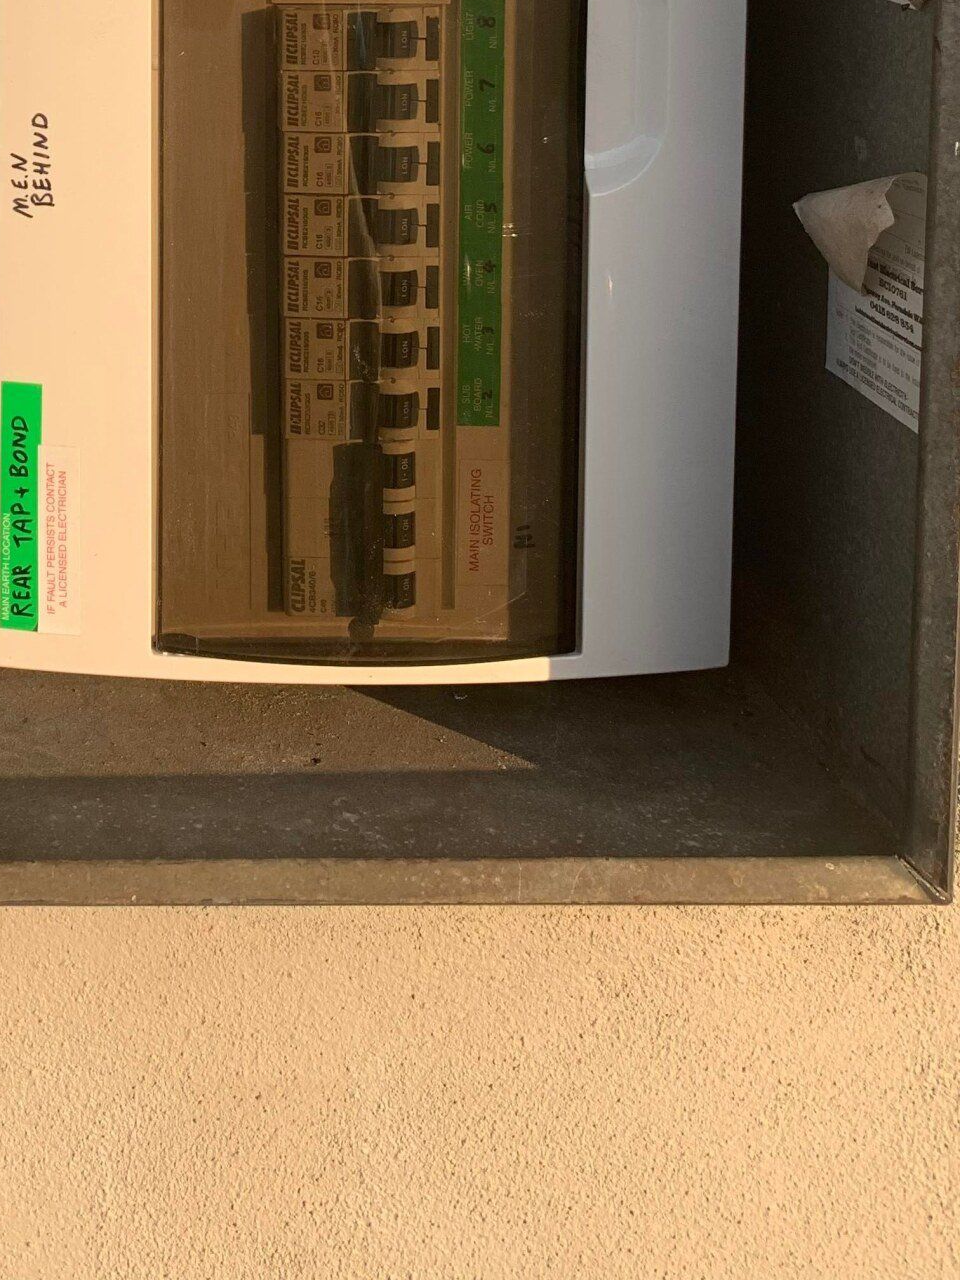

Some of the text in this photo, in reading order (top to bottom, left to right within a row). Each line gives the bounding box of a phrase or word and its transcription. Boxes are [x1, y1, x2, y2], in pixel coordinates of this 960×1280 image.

[286, 13, 298, 55] CLIPSAL
[465, 10, 474, 42] LIGHT
[476, 15, 496, 29] 8
[286, 75, 299, 116] CLIPSAL
[465, 70, 474, 108] POWER
[478, 78, 496, 93] 7
[30, 113, 55, 207] BEHIND
[287, 136, 299, 178] CLIPSAL
[465, 132, 474, 169] POWER
[476, 142, 496, 155] 6
[287, 198, 299, 240] CLIPSAL
[464, 204, 473, 221] AIR
[287, 261, 299, 302] CLIPSAL
[475, 260, 484, 287] OVEN
[289, 322, 301, 363] CLIPSAL
[462, 323, 471, 343] HOT
[473, 316, 483, 351] WATER
[290, 383, 301, 424] CLIPSAL
[462, 384, 471, 405] SUB
[473, 377, 483, 412] BOARD
[8, 416, 34, 618] REAR TAP + BOND
[468, 467, 482, 572] MAIN ISOLATING
[482, 495, 494, 546] SWITCH
[46, 462, 56, 615] IF FAULT PERSISTS CONTACT
[58, 470, 68, 608] A LICENSED ELECTRICIAN
[1, 512, 11, 621] MAIN EARTH LOCATION
[290, 558, 306, 613] CLIPSAL
